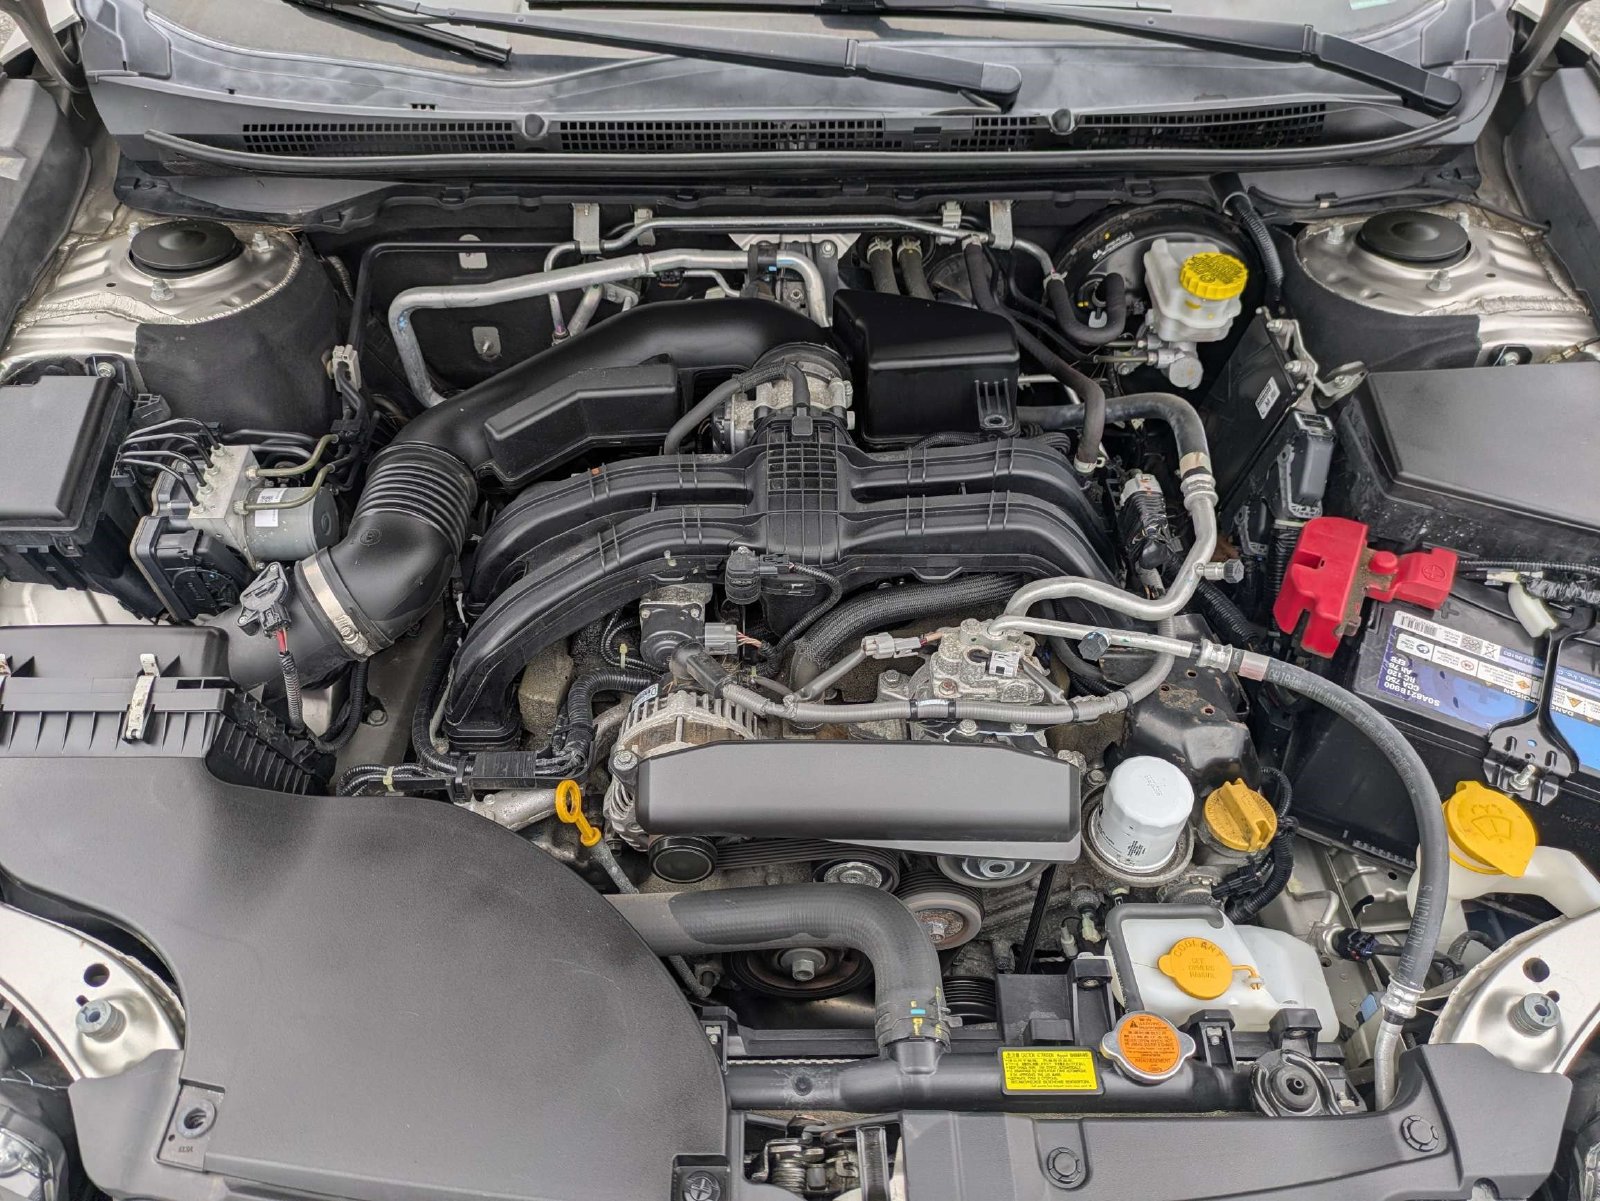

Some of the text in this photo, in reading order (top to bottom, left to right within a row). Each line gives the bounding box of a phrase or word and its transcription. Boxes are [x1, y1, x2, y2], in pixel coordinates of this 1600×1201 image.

[1385, 675, 1420, 692] CCA 750
[1387, 669, 1416, 683] RC 120
